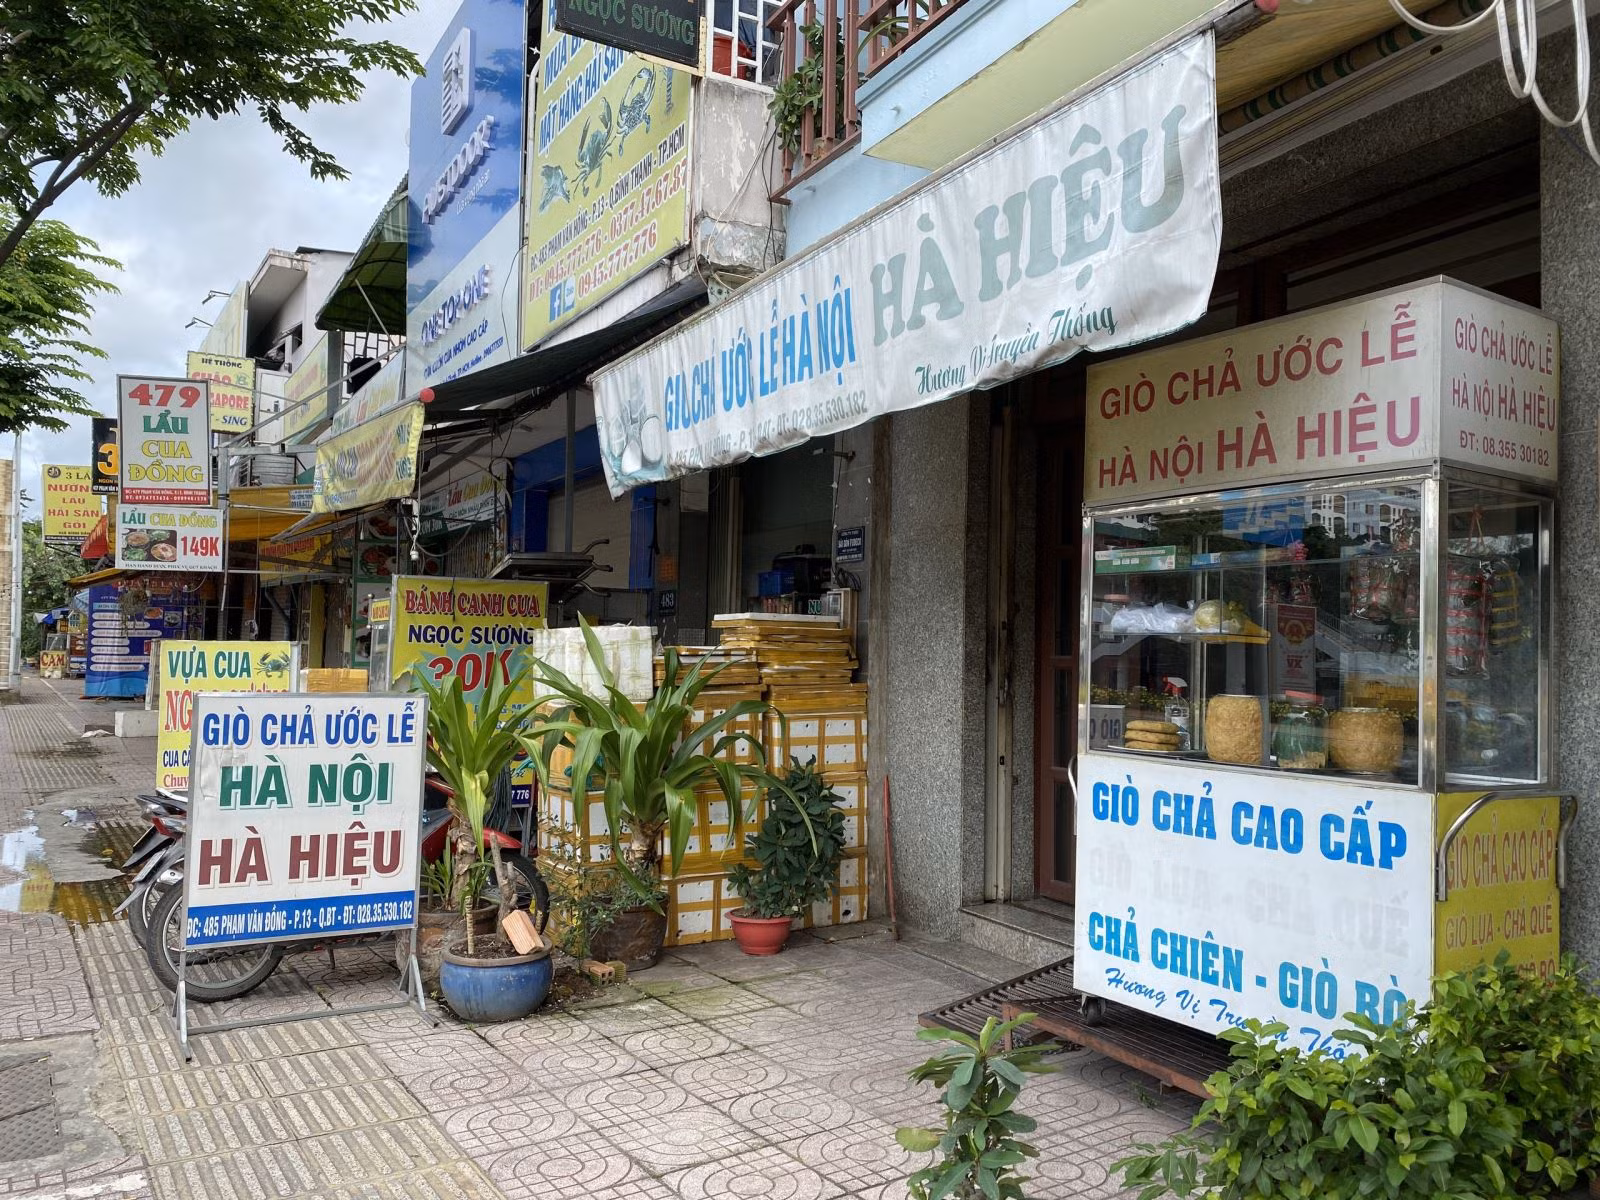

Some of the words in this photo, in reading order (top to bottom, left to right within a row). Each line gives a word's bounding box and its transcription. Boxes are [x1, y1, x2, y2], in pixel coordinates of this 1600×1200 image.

[631, 3, 695, 46] SƯƠNG
[544, 34, 568, 91] MUA
[870, 213, 964, 346] HÀ
[974, 105, 1186, 301] HIỆU
[782, 294, 813, 386] HÀ
[817, 274, 856, 386] NỘI
[915, 364, 966, 395] Hương
[1050, 302, 1118, 346] Thống
[1455, 316, 1477, 354] GIÒ
[1481, 320, 1506, 364] CHẢ
[1510, 328, 1535, 371] ƯỚC
[1538, 333, 1554, 376] LỄ
[1101, 372, 1155, 420] GIÒ
[1167, 347, 1241, 405] CHẢ
[1257, 334, 1343, 388] ƯỚC
[1361, 300, 1417, 368] LỄ
[128, 383, 200, 408] 479
[792, 390, 868, 431] 028.35.530.182
[1452, 376, 1469, 410] HÀ
[1473, 381, 1494, 417] NỘI
[1498, 376, 1518, 423] HÀ
[1523, 386, 1556, 435] HIỆU
[143, 410, 189, 434] LẨU
[221, 416, 247, 426] SING
[1100, 445, 1137, 489] HÀ
[1150, 436, 1204, 484] NỘI
[1217, 410, 1277, 472] HÀ
[1296, 392, 1421, 463] HIỆU
[141, 440, 192, 458] CUA
[1459, 430, 1480, 456] ĐT:
[1482, 436, 1517, 461] 08.355
[1519, 442, 1550, 467] 30182
[48, 484, 91, 493] NƯỚN
[128, 459, 203, 482] ĐỒNG
[122, 508, 146, 524] LẨU
[150, 513, 176, 526] CUA
[179, 511, 217, 528] ĐỒNG
[181, 536, 220, 556] 149K
[405, 585, 453, 614] BÁNH
[457, 593, 503, 615] CANH
[506, 594, 540, 616] CUA
[661, 593, 674, 607] 483
[408, 625, 463, 647] NGỌC
[470, 623, 533, 645] SƯƠNG
[41, 651, 65, 667] CAM
[168, 645, 207, 684] VỰA
[214, 651, 251, 678] CUA
[165, 690, 192, 731] NG
[203, 706, 250, 745] GIÒ
[260, 704, 315, 745] CHẢ
[325, 706, 377, 745] ƯỚC
[387, 701, 415, 743] LỄ
[163, 750, 179, 767] CUA
[163, 774, 189, 788] Chuy
[220, 754, 288, 807] HÀ
[308, 753, 390, 811] NỘI
[517, 790, 529, 800] 776
[1092, 774, 1140, 826] GIÒ
[1152, 781, 1217, 841] CHẢ
[1231, 801, 1304, 855] CAO
[1319, 800, 1407, 870] CẤP
[198, 825, 269, 886] HÀ
[288, 821, 402, 886] HIỆU
[1447, 825, 1469, 890] GIÒ
[1473, 813, 1498, 887] CHẢ
[1502, 830, 1526, 884] CAO
[1530, 806, 1553, 881] CẤP
[187, 917, 202, 939] ĐC:
[203, 915, 219, 937] 485
[221, 914, 245, 939] PHẠM
[247, 912, 263, 934] VĂN
[264, 904, 286, 931] ĐỒNG
[294, 909, 311, 930] P.13
[319, 907, 337, 928] Q.BT
[343, 905, 355, 926] ĐT:
[357, 900, 413, 923] 028.35.530.182
[1446, 910, 1467, 949] GIÒ
[1472, 913, 1493, 950] LỤA
[1504, 896, 1526, 940] CHẢ
[1530, 896, 1552, 936] QUẾ
[1088, 906, 1140, 964] CHẢ
[1150, 930, 1245, 994] CHIÊN
[1278, 957, 1338, 1021] GIÒ
[1355, 975, 1408, 1031] BÒ
[1105, 967, 1167, 1007] Hương
[1175, 989, 1201, 1020] Vị
[1209, 999, 1288, 1043] Trun
[1300, 1026, 1351, 1062] Thố
